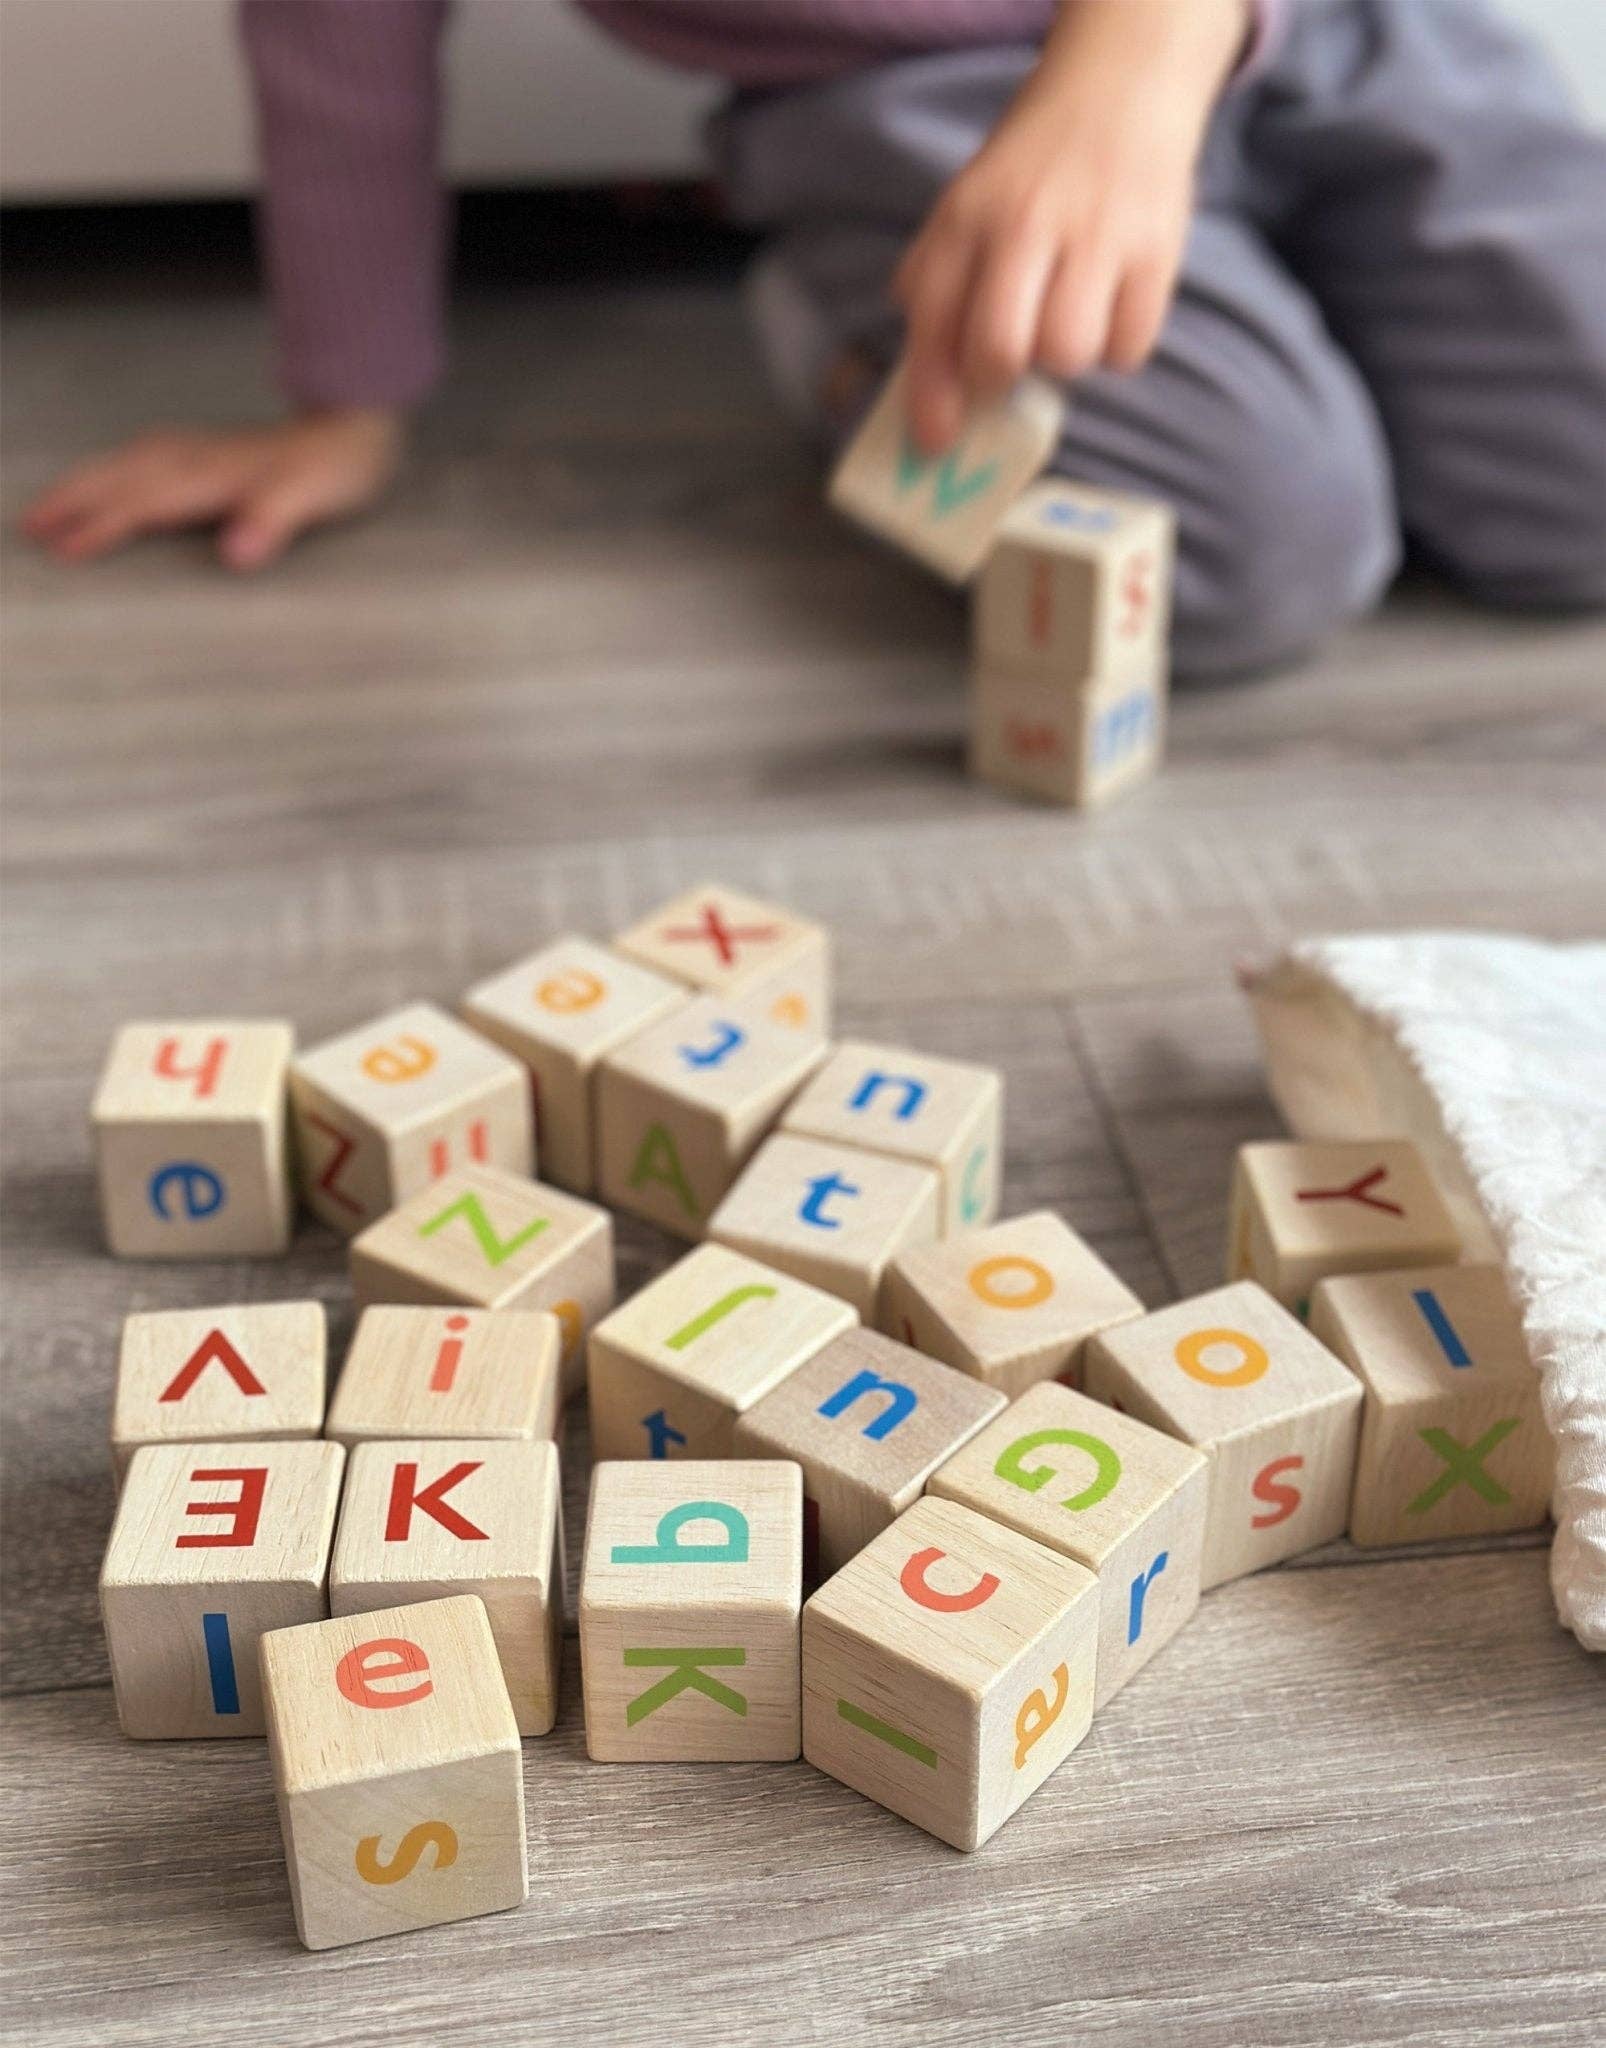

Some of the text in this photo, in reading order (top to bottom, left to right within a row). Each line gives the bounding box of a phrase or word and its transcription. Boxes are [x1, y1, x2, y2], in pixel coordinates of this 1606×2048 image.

[664, 905, 779, 967] X
[147, 1161, 226, 1222] e
[627, 1123, 700, 1217] A
[797, 1173, 858, 1229] t
[1296, 1169, 1402, 1215] Y
[431, 1317, 467, 1392] i
[818, 1370, 917, 1440] n
[385, 1463, 487, 1541] K
[994, 1429, 1122, 1511] G
[1408, 1418, 1520, 1512] X
[176, 1468, 267, 1548] E
[1128, 1551, 1168, 1646] r
[336, 1639, 432, 1709] e
[624, 1647, 746, 1727] K
[1014, 1664, 1069, 1769] a
